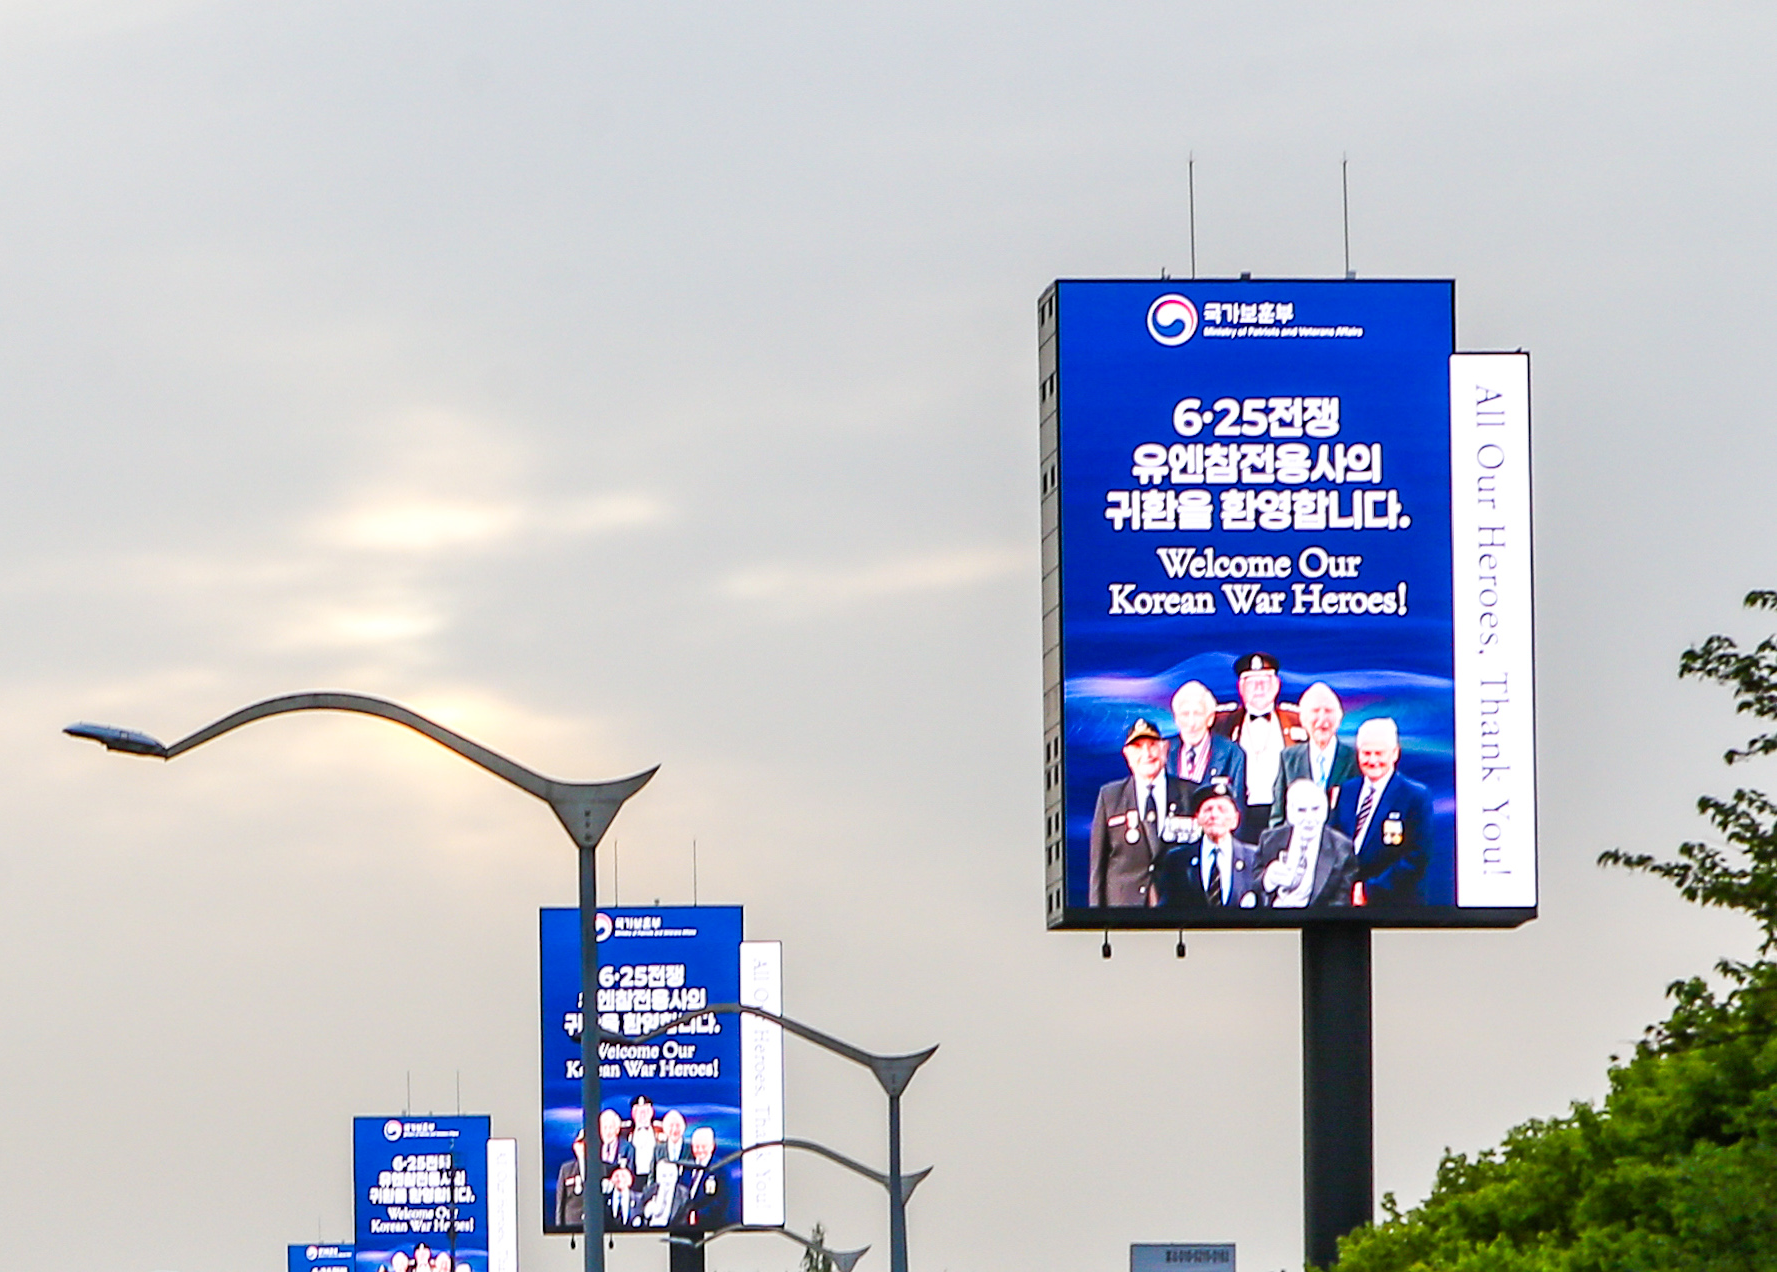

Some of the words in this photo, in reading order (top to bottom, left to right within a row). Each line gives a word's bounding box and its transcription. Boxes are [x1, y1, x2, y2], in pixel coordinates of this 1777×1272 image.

[1173, 398, 1340, 438] 6·25전쟁
[1475, 384, 1506, 428] All
[1132, 443, 1382, 485] 유엔참전용사의
[1476, 443, 1506, 510] Our
[1105, 489, 1214, 531] 귀환을
[1219, 489, 1411, 531] 환영합니다.
[1157, 547, 1292, 579] Welcome
[1298, 547, 1362, 579] Our
[1108, 583, 1215, 616] Korean
[1222, 583, 1286, 616] War
[1291, 582, 1407, 617] Heroes!
[1479, 671, 1511, 782] Thank
[1481, 798, 1512, 875] You!
[622, 1058, 657, 1079] War
[662, 1041, 696, 1060] Our
